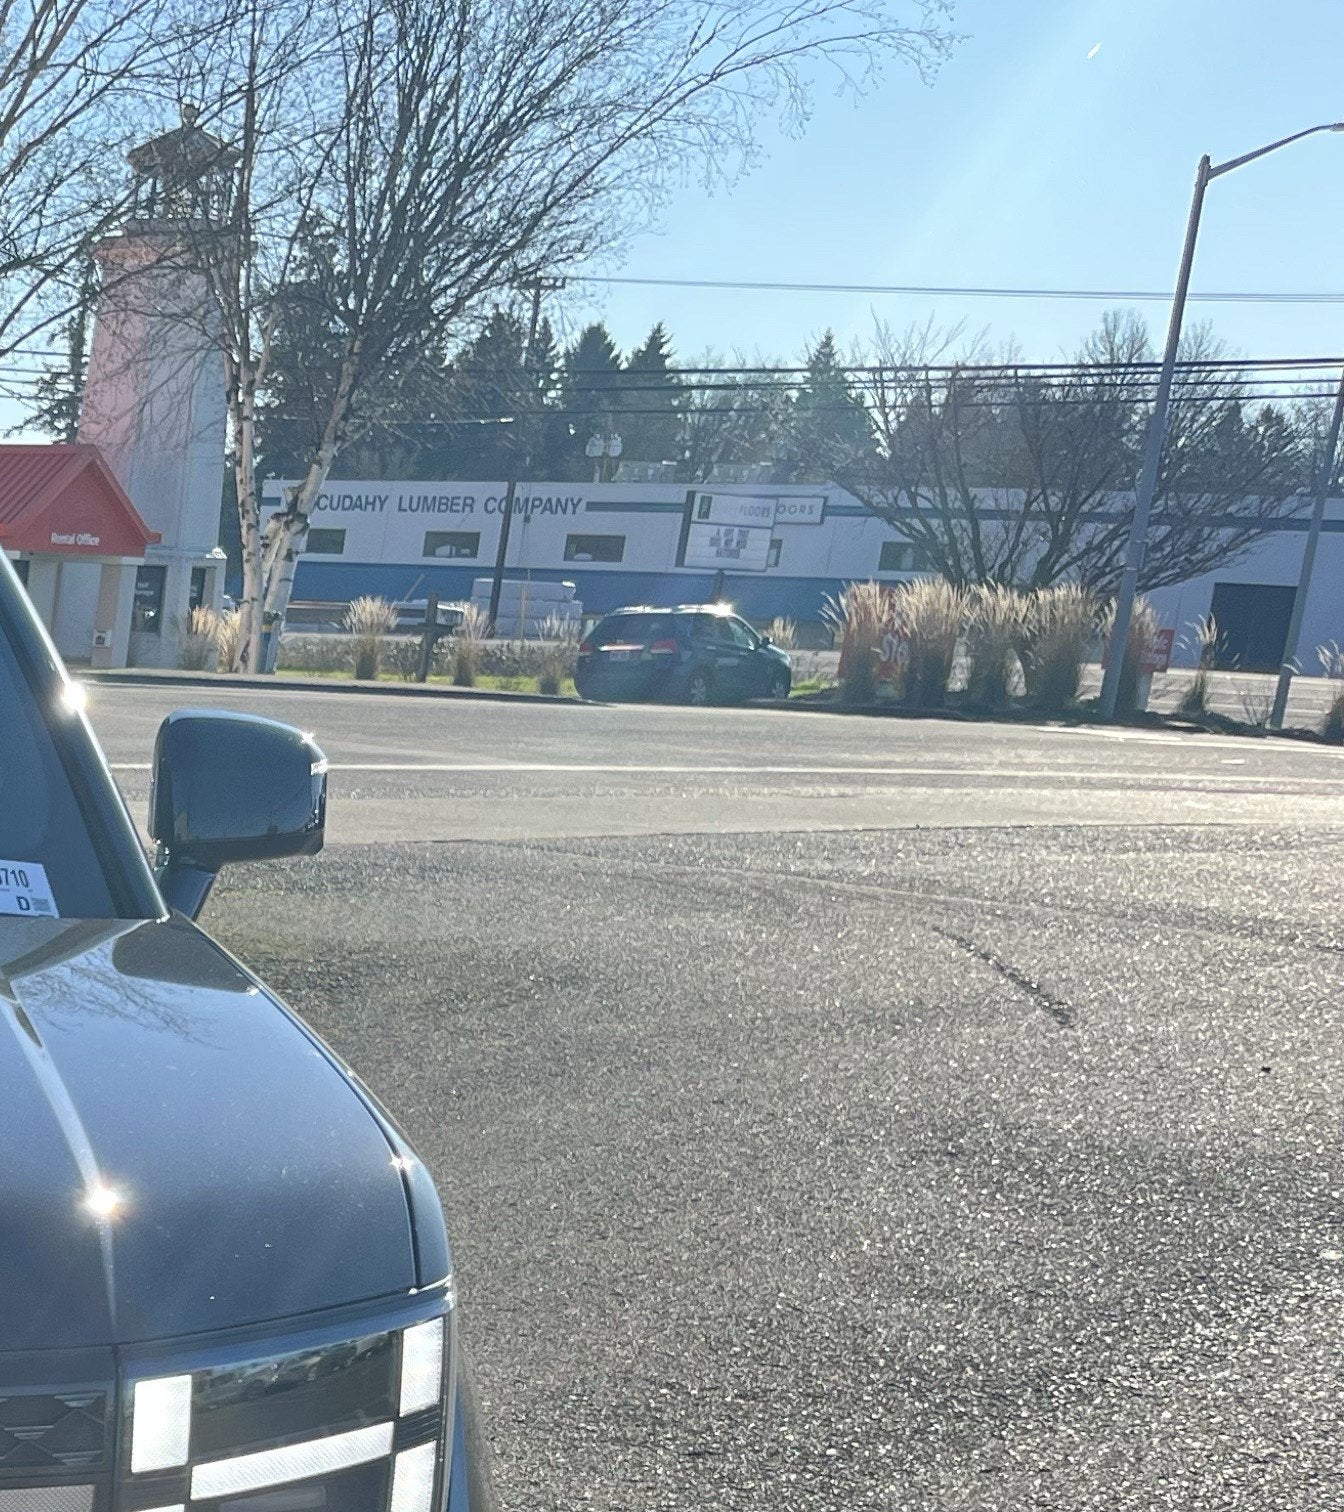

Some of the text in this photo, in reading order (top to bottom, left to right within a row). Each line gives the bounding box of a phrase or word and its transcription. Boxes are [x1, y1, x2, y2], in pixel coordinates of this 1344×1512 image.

[316, 494, 582, 516] CUDAHY LUMBER COMPANY
